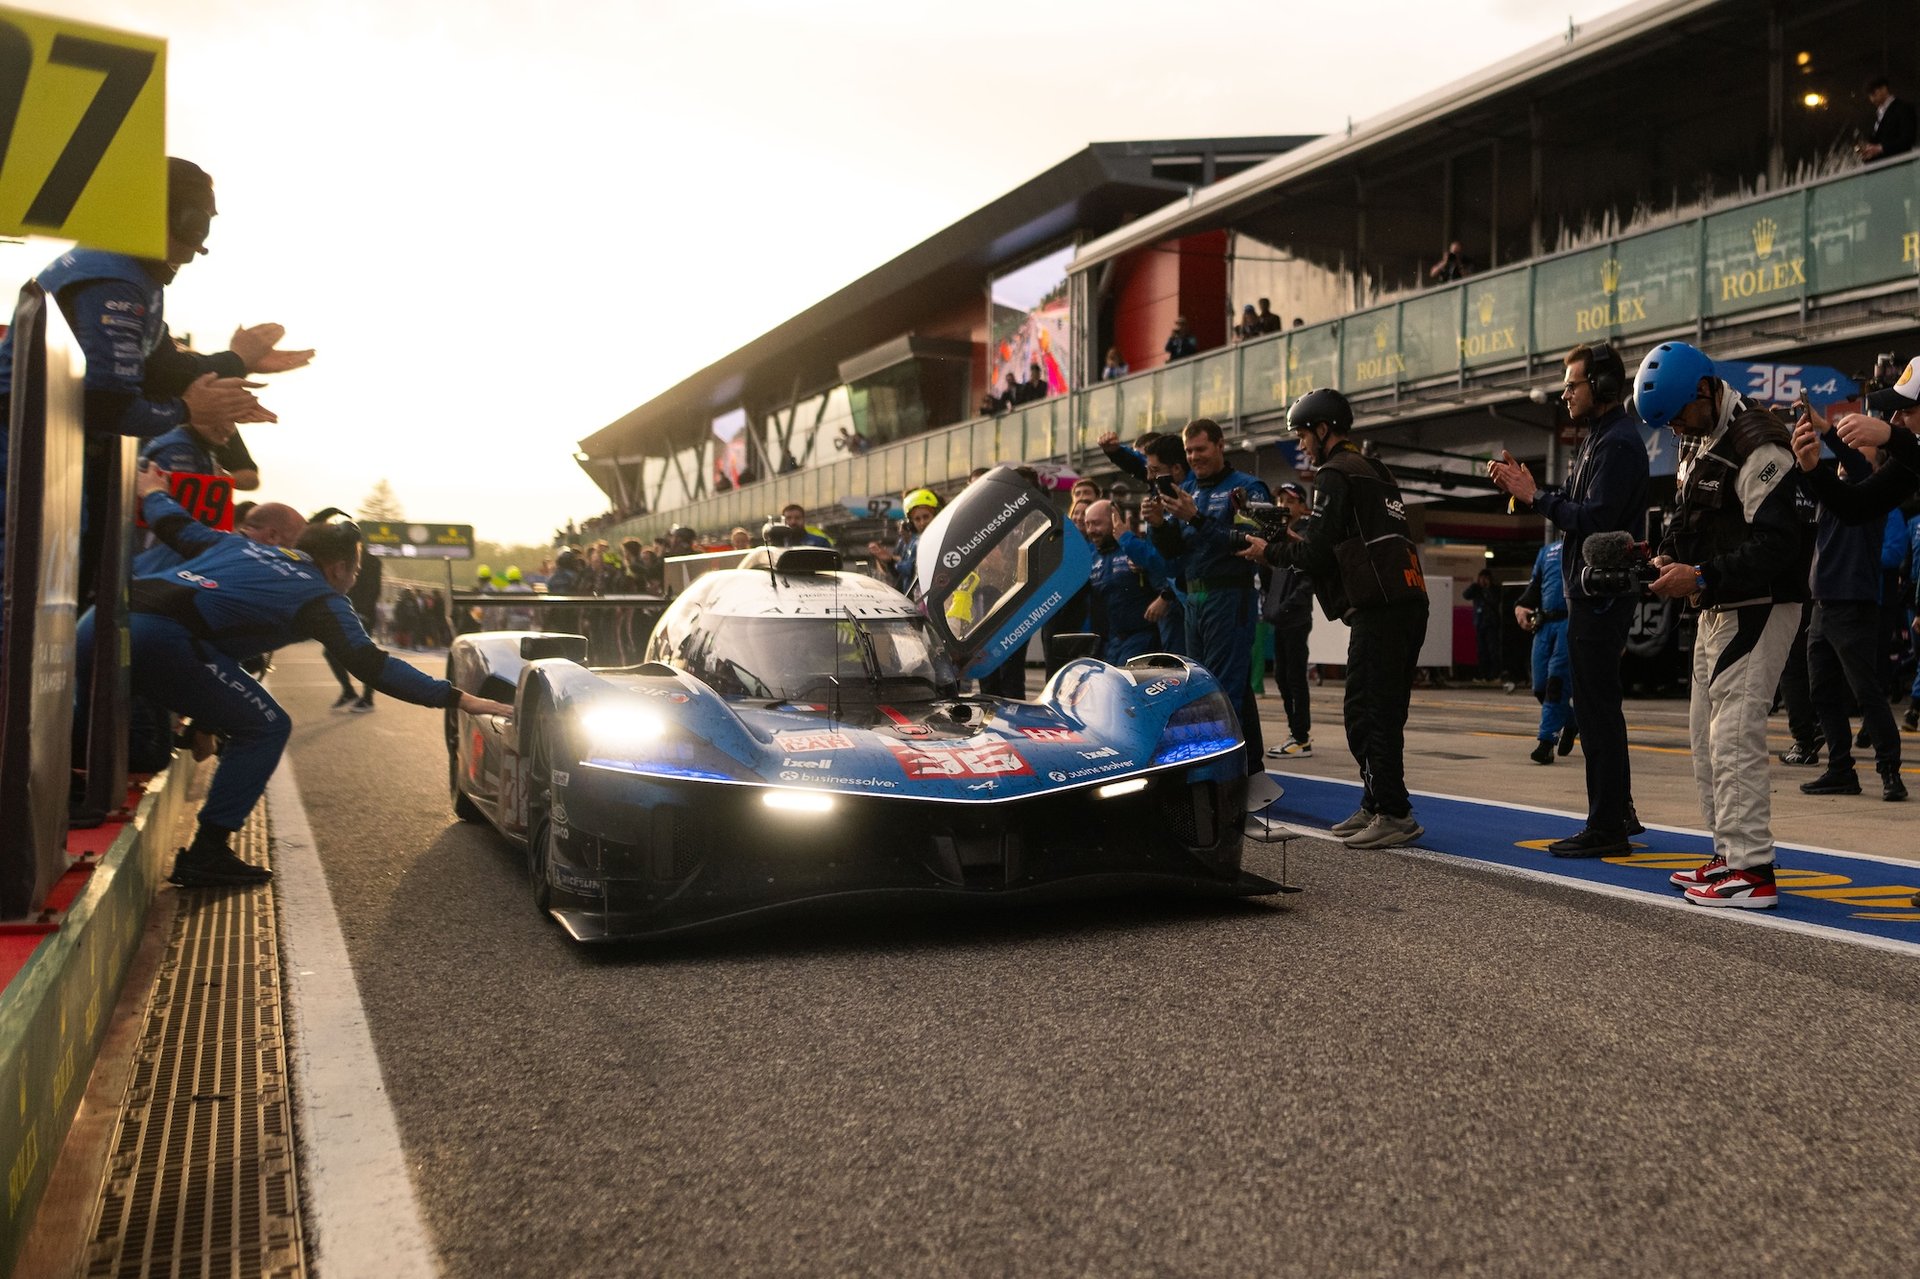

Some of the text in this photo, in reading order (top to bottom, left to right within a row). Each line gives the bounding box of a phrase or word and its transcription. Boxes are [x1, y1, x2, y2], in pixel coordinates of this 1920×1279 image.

[1721, 257, 1806, 301] ROLEX
[1575, 297, 1646, 333] ROLEX
[1457, 327, 1515, 359] ROLEX
[1356, 353, 1406, 381] ROLEX
[1747, 363, 1803, 401] 36
[1759, 462, 1778, 483] OMP
[867, 500, 892, 518] 92
[958, 492, 1030, 556] businessolver
[760, 606, 918, 616] ALPINE
[1000, 591, 1062, 650] MOSER.WATCH
[205, 663, 277, 722] ALPINE
[629, 686, 669, 696] elf
[1144, 680, 1168, 696] elf
[1022, 728, 1072, 741] HY
[897, 743, 1025, 775] 36
[801, 772, 899, 788] businessolver
